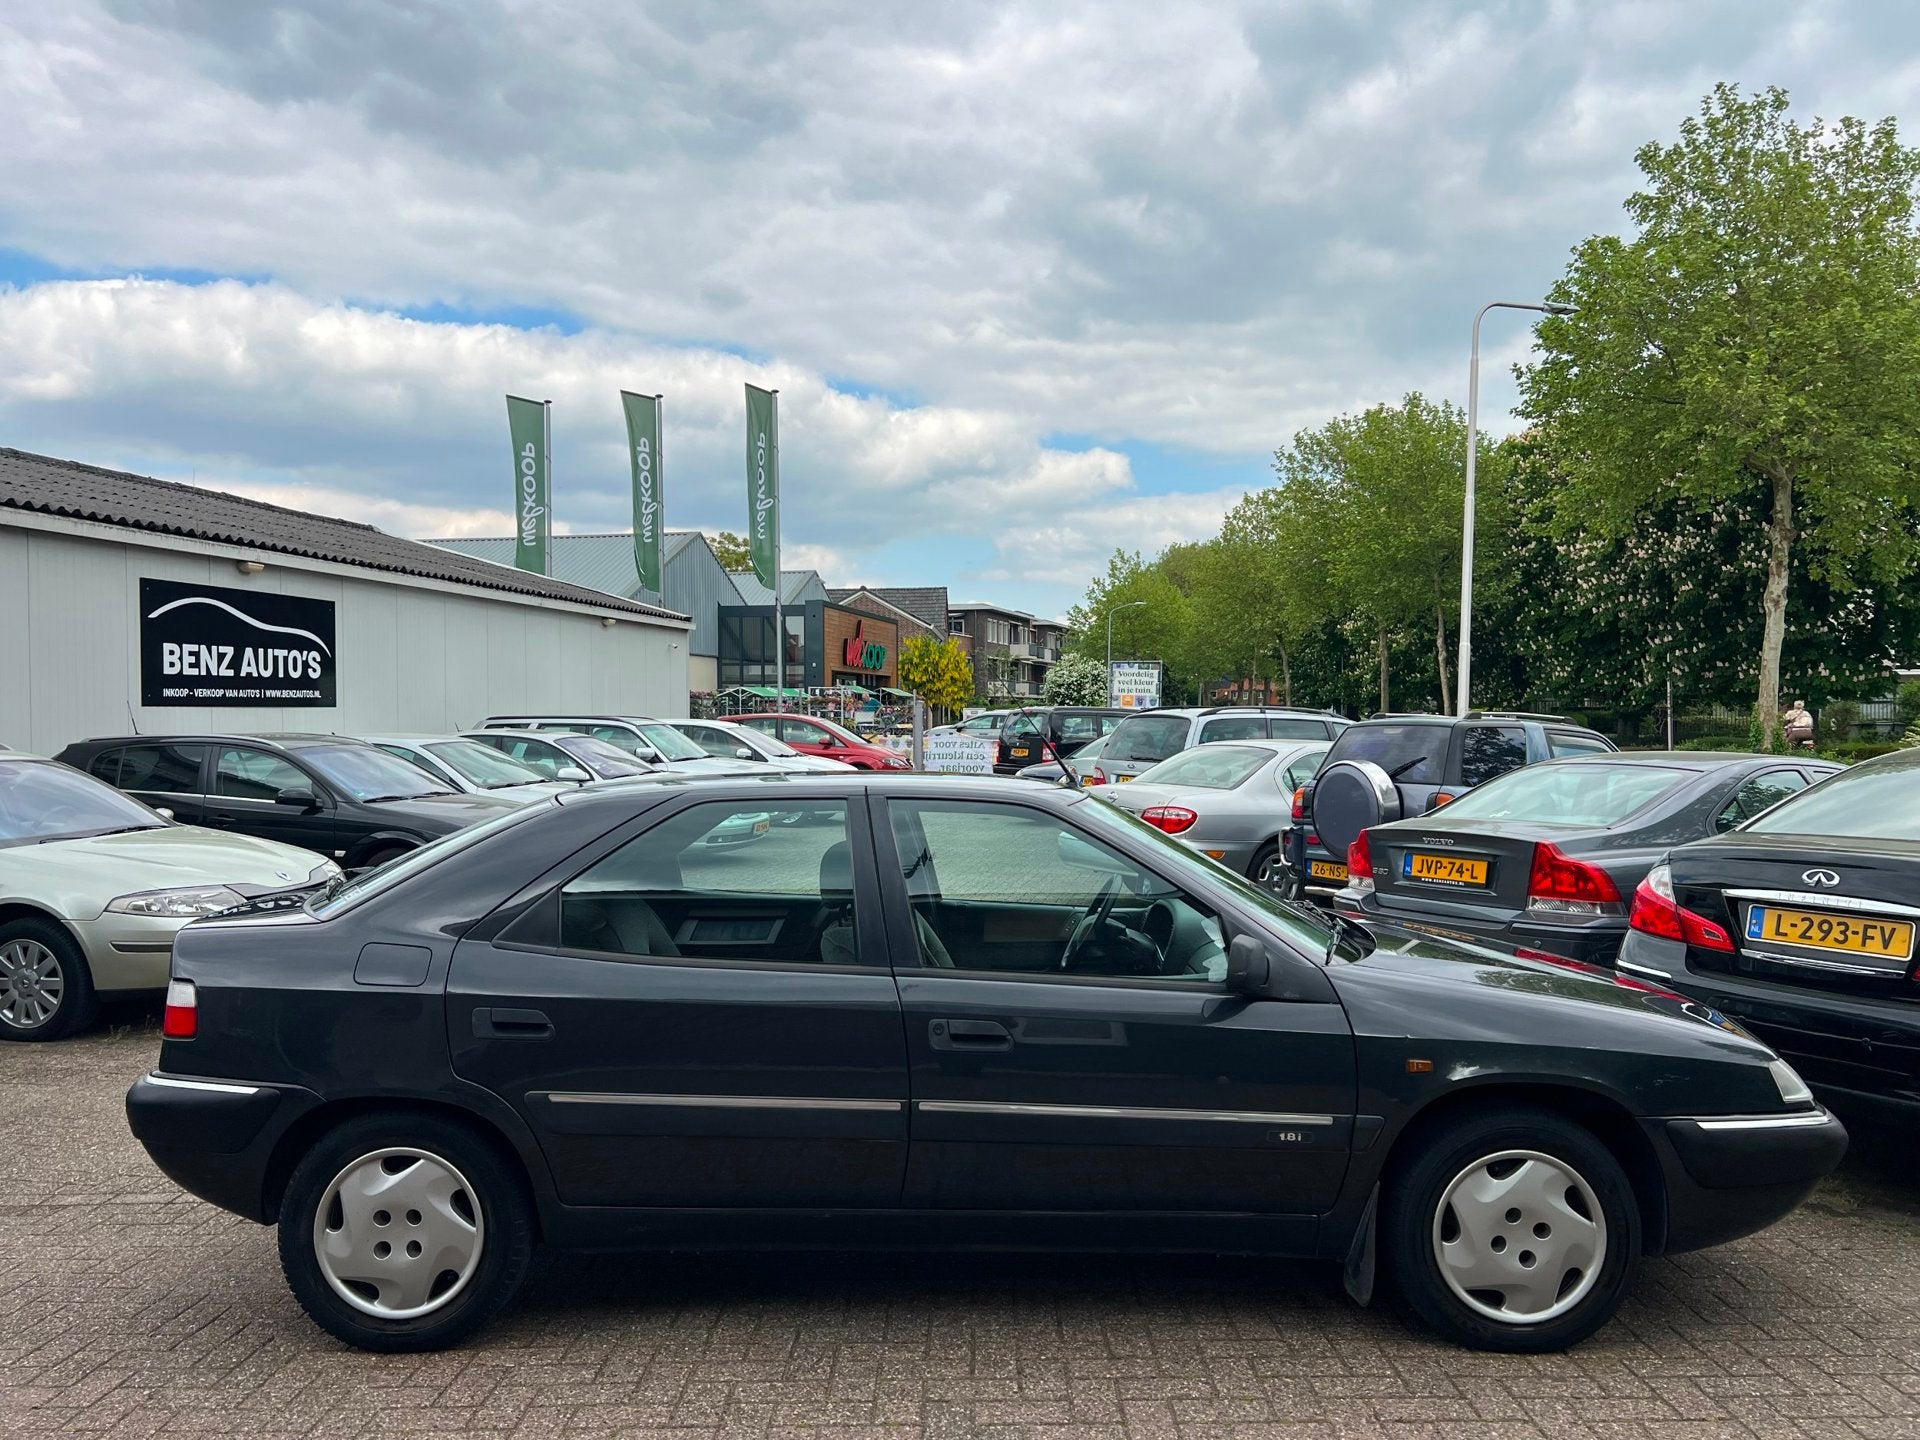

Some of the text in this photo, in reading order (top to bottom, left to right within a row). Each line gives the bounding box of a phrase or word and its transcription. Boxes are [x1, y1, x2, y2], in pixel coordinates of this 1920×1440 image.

[162, 642, 322, 679] BENZ AUTO'S
[163, 688, 189, 697] INKOOP
[194, 688, 224, 698] VERKOOP
[225, 689, 238, 698] VAN
[239, 689, 260, 698] AUTO'S
[265, 690, 321, 698] WWW.BENZAUTOS.NL
[1422, 837, 1454, 846] VOLVO
[1314, 863, 1348, 878] 26-NS-
[1417, 858, 1478, 880] JVP-74-L
[1751, 913, 1896, 950] NL L-293-FV
